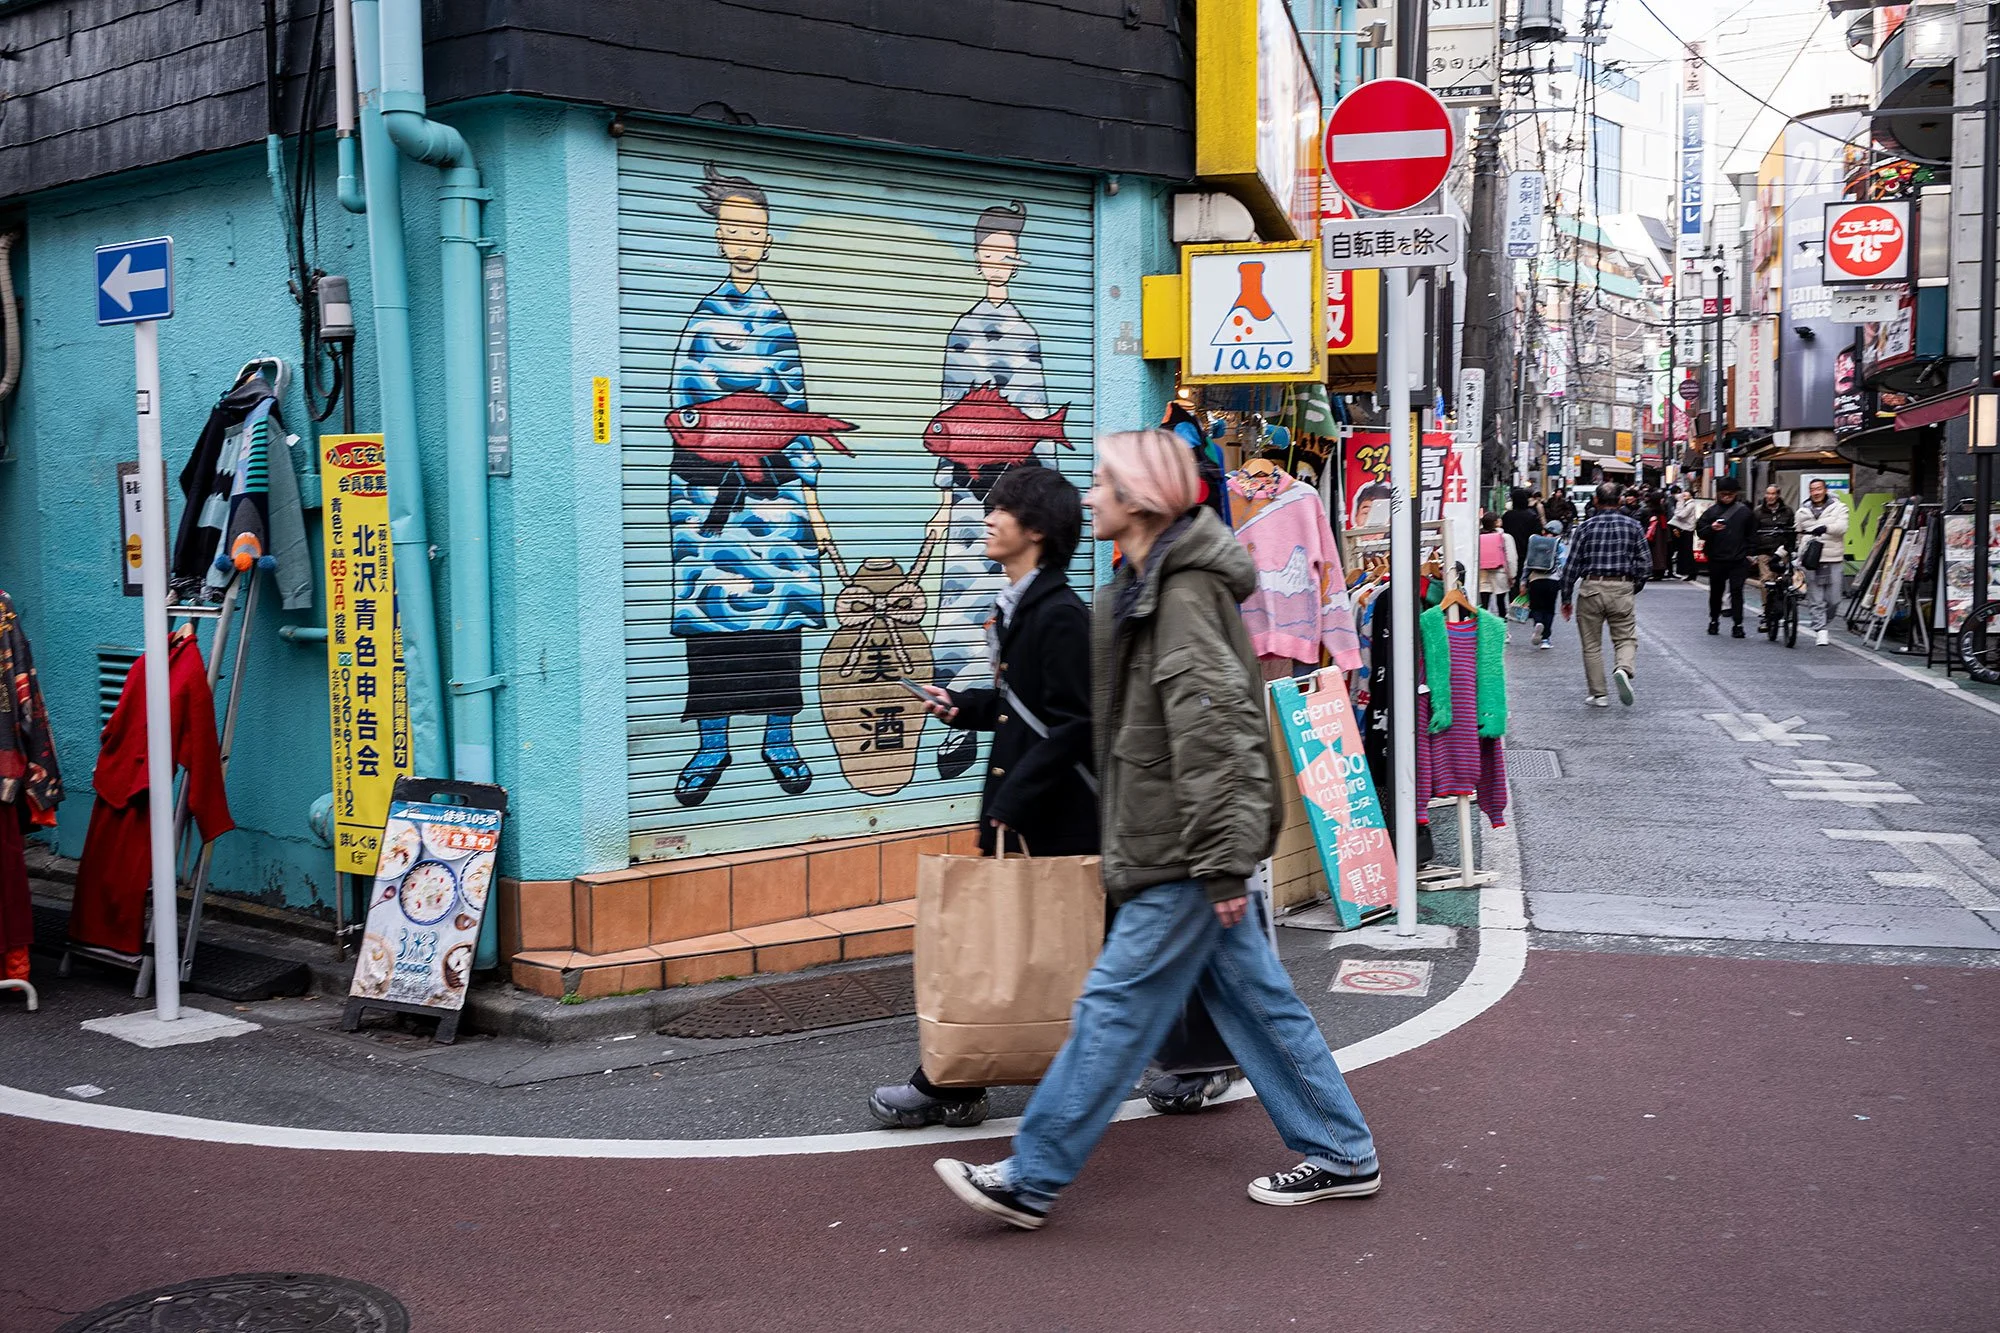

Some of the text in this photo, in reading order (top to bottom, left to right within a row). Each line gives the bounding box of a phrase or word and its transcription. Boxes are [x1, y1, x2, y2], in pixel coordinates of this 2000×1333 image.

[1684, 154, 1699, 223] アンドレ
[1332, 228, 1449, 259] 自転車を除く
[1116, 340, 1138, 352] 15-1
[1213, 346, 1294, 373] labo
[338, 474, 387, 492] 会員募集
[378, 523, 389, 593] 一般社団法人
[352, 524, 380, 777] 北沢青色申告会
[859, 637, 905, 752] 美酒
[1292, 699, 1344, 726] etienne
[1301, 720, 1342, 743] marcel
[1299, 740, 1365, 787] labo
[1316, 777, 1366, 804] ratoire
[340, 832, 377, 850] 詳しくは
[450, 833, 492, 848] 営業中
[1346, 863, 1386, 898] 買取
